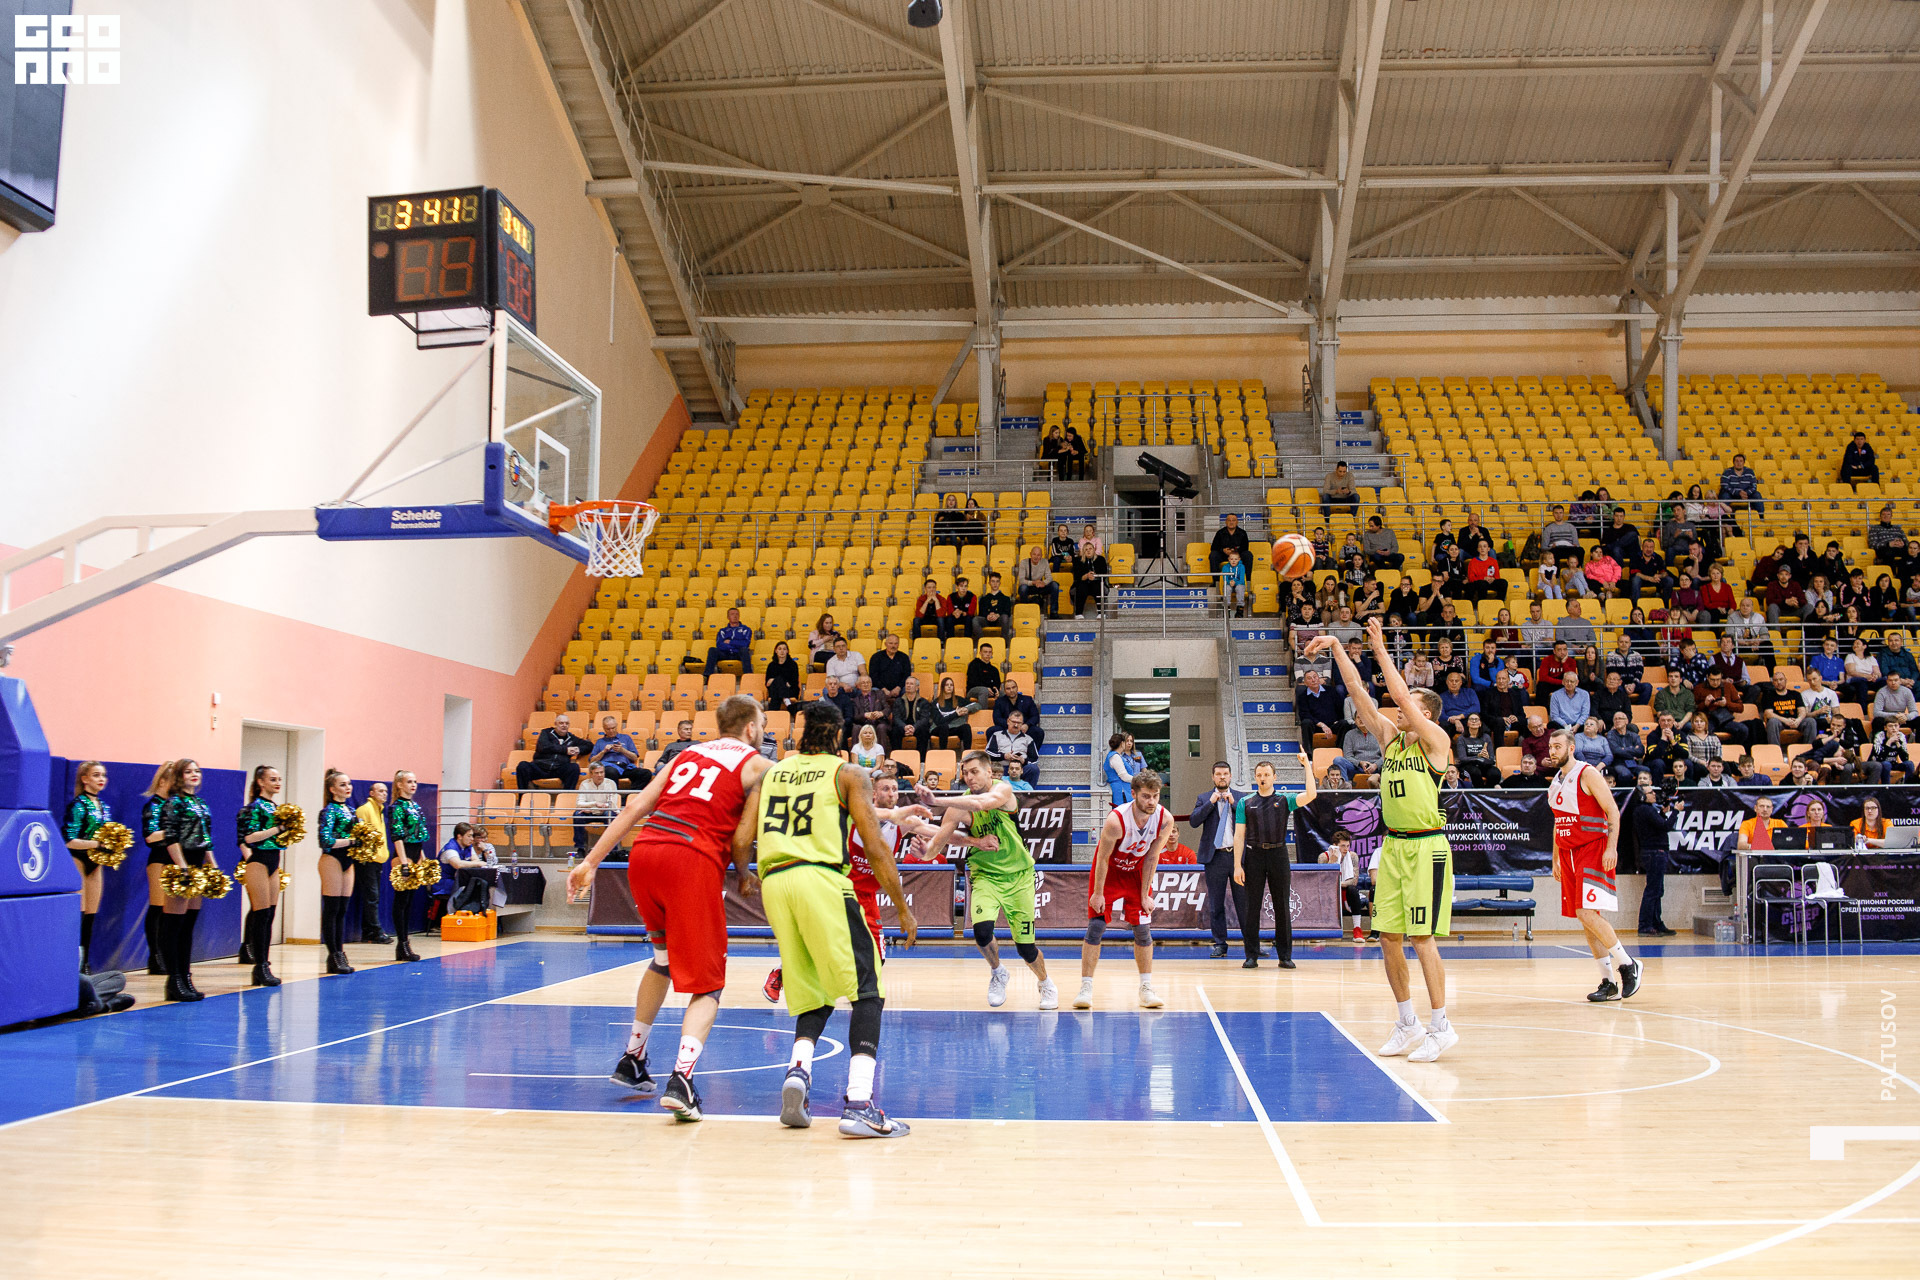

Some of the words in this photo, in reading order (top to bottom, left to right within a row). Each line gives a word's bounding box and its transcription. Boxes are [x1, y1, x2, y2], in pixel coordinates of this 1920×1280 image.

[391, 509, 442, 521] Schelde
[390, 521, 441, 529] International
[1063, 634, 1069, 642] A
[1074, 634, 1080, 642] 6
[1248, 632, 1255, 640] B
[1260, 632, 1266, 640] 6
[1060, 668, 1067, 677] A
[1071, 668, 1077, 677] 5
[1252, 667, 1260, 676] B
[1264, 667, 1271, 676] 5
[1058, 706, 1065, 714] A
[1070, 706, 1076, 714] 4
[1257, 704, 1264, 712] B
[1269, 704, 1276, 712] 4
[1056, 745, 1064, 754] A
[1068, 745, 1075, 754] 3
[1262, 743, 1269, 752] B
[1275, 743, 1281, 752] 3
[667, 761, 721, 802] 91
[1388, 779, 1406, 798] 10
[1555, 791, 1564, 806] 6
[763, 792, 816, 837] 98
[1463, 812, 1483, 820] XXIX
[1482, 822, 1519, 830] РОССИИ
[1448, 833, 1490, 841] МУЖСКИХ
[1492, 833, 1530, 841] КОМАНД
[1667, 831, 1732, 850] МАТ
[1472, 843, 1506, 851] 2019/20
[1586, 888, 1597, 903] 6
[1410, 906, 1427, 925] 10
